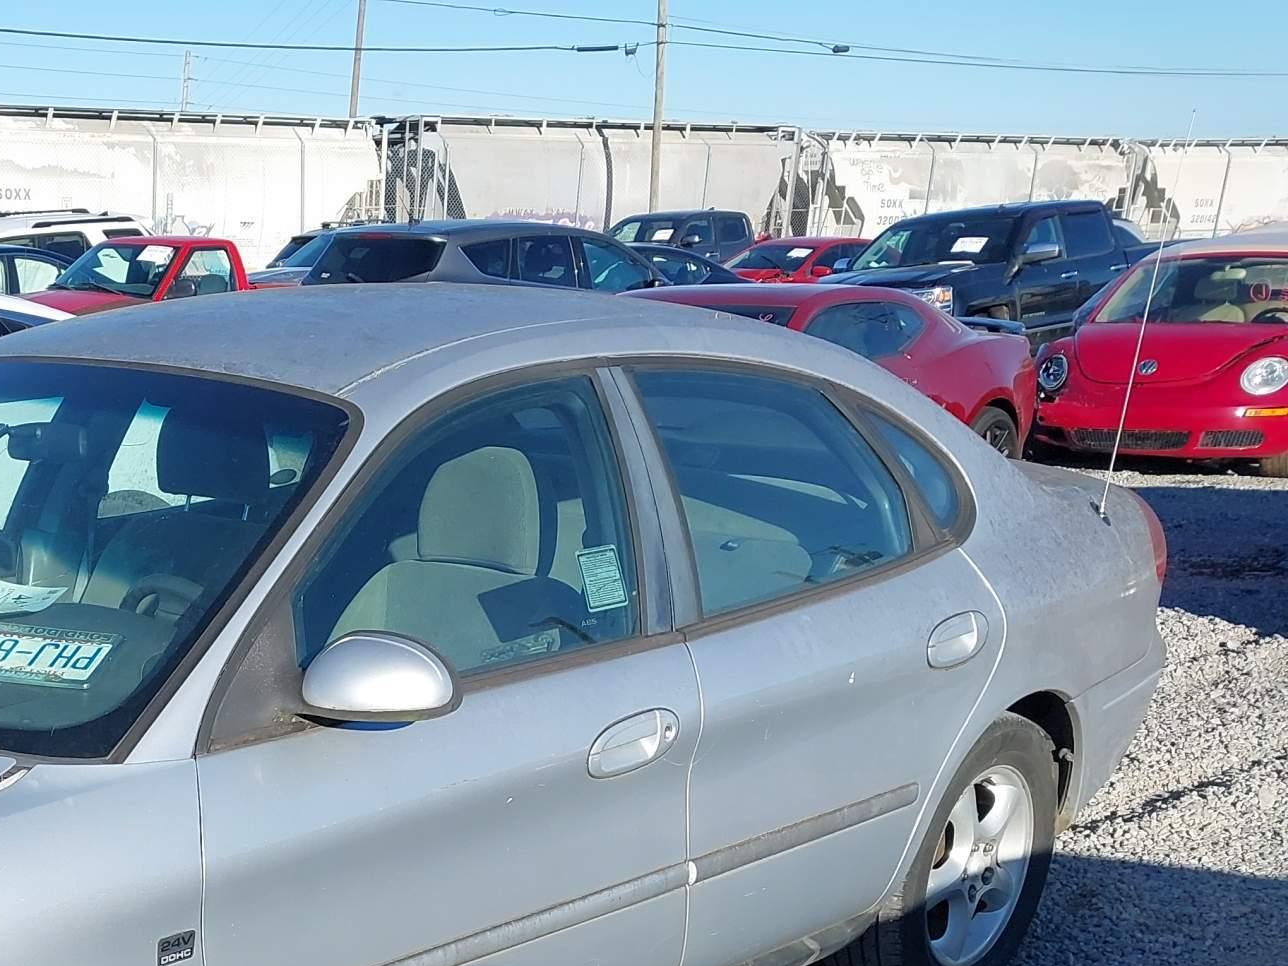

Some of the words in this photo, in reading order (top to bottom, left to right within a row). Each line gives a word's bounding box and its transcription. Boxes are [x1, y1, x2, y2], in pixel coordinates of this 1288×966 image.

[880, 199, 904, 209] SOXX
[161, 933, 193, 952] 24V
[161, 949, 192, 964] DOHC
